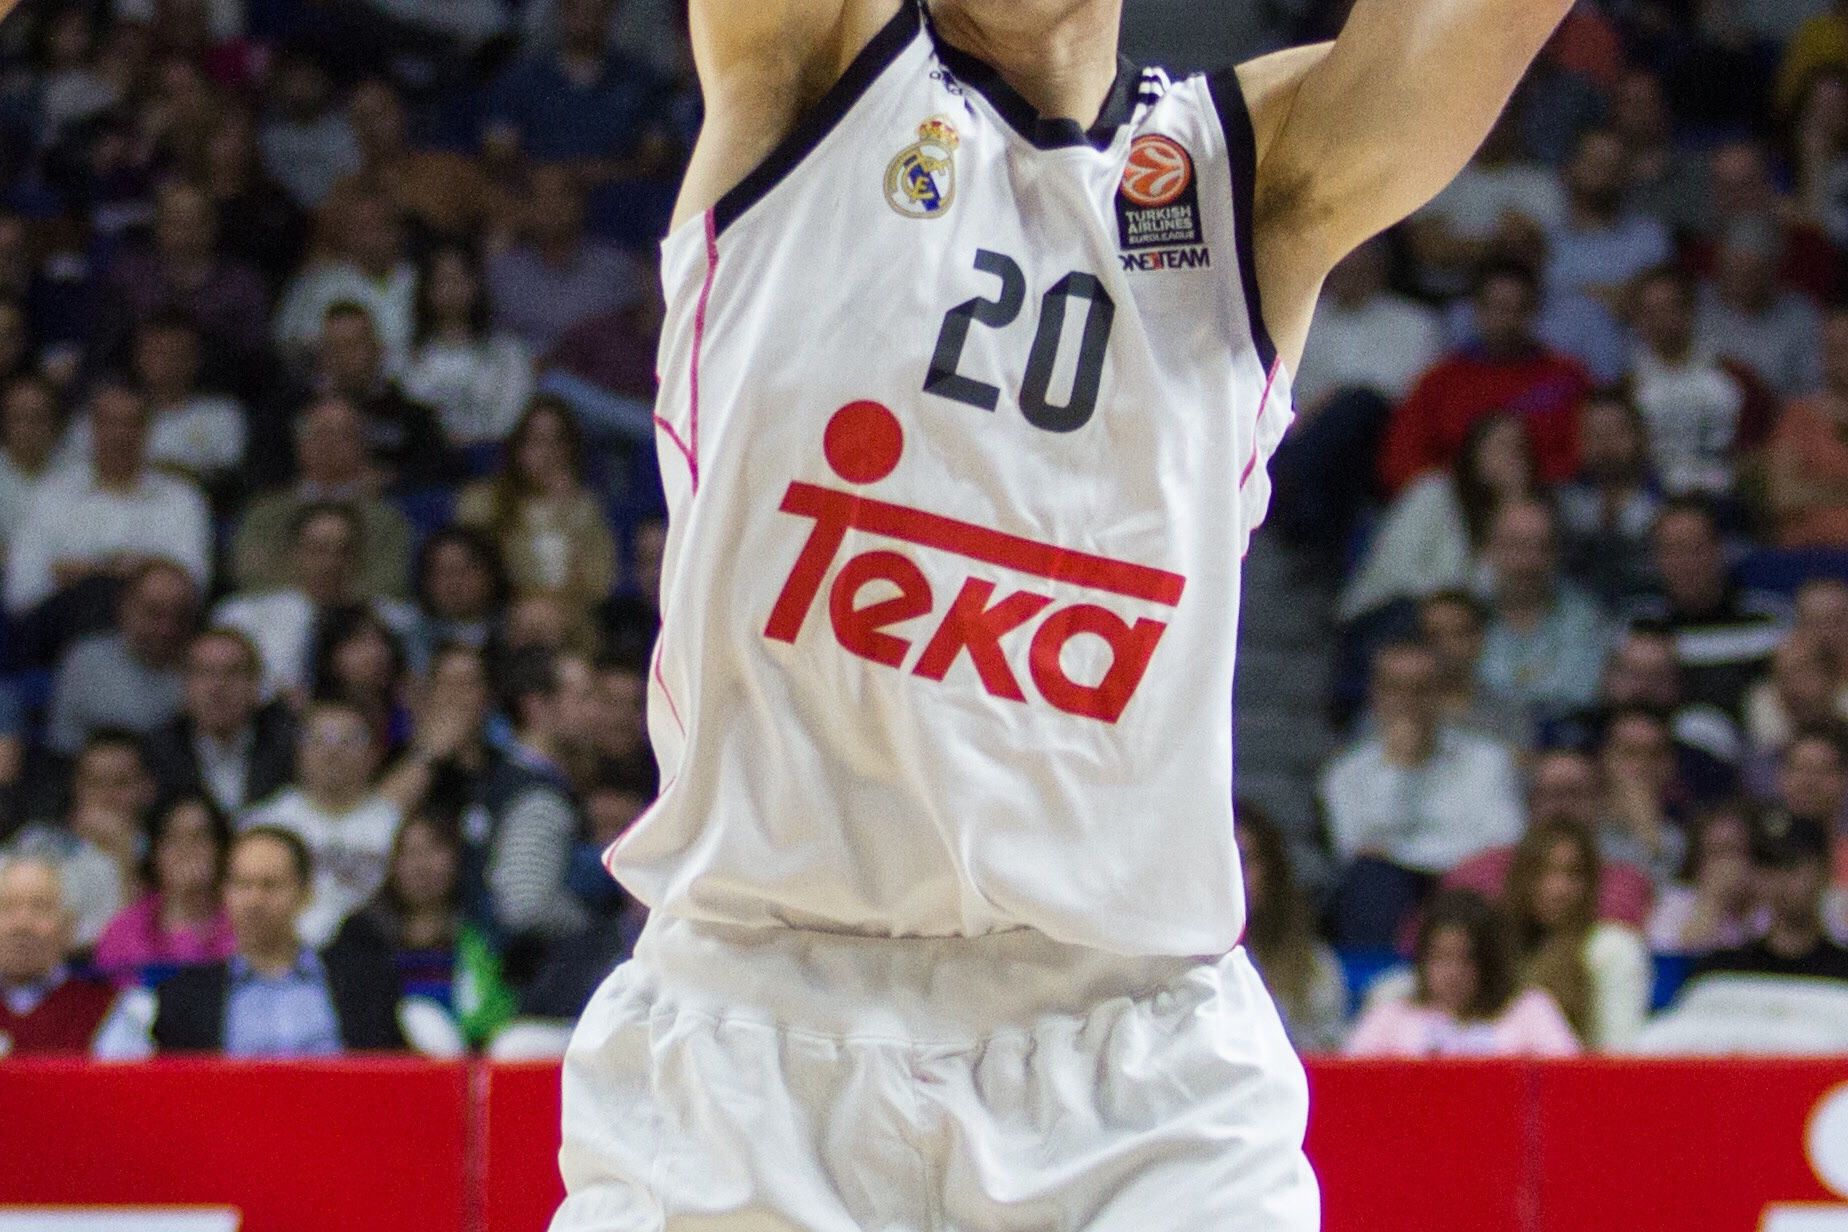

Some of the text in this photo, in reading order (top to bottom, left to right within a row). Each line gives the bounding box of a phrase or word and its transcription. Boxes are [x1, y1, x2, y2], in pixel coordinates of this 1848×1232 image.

[1126, 205, 1191, 221] TURKISH
[1128, 217, 1193, 235] AIRLINES
[923, 248, 1116, 434] 20
